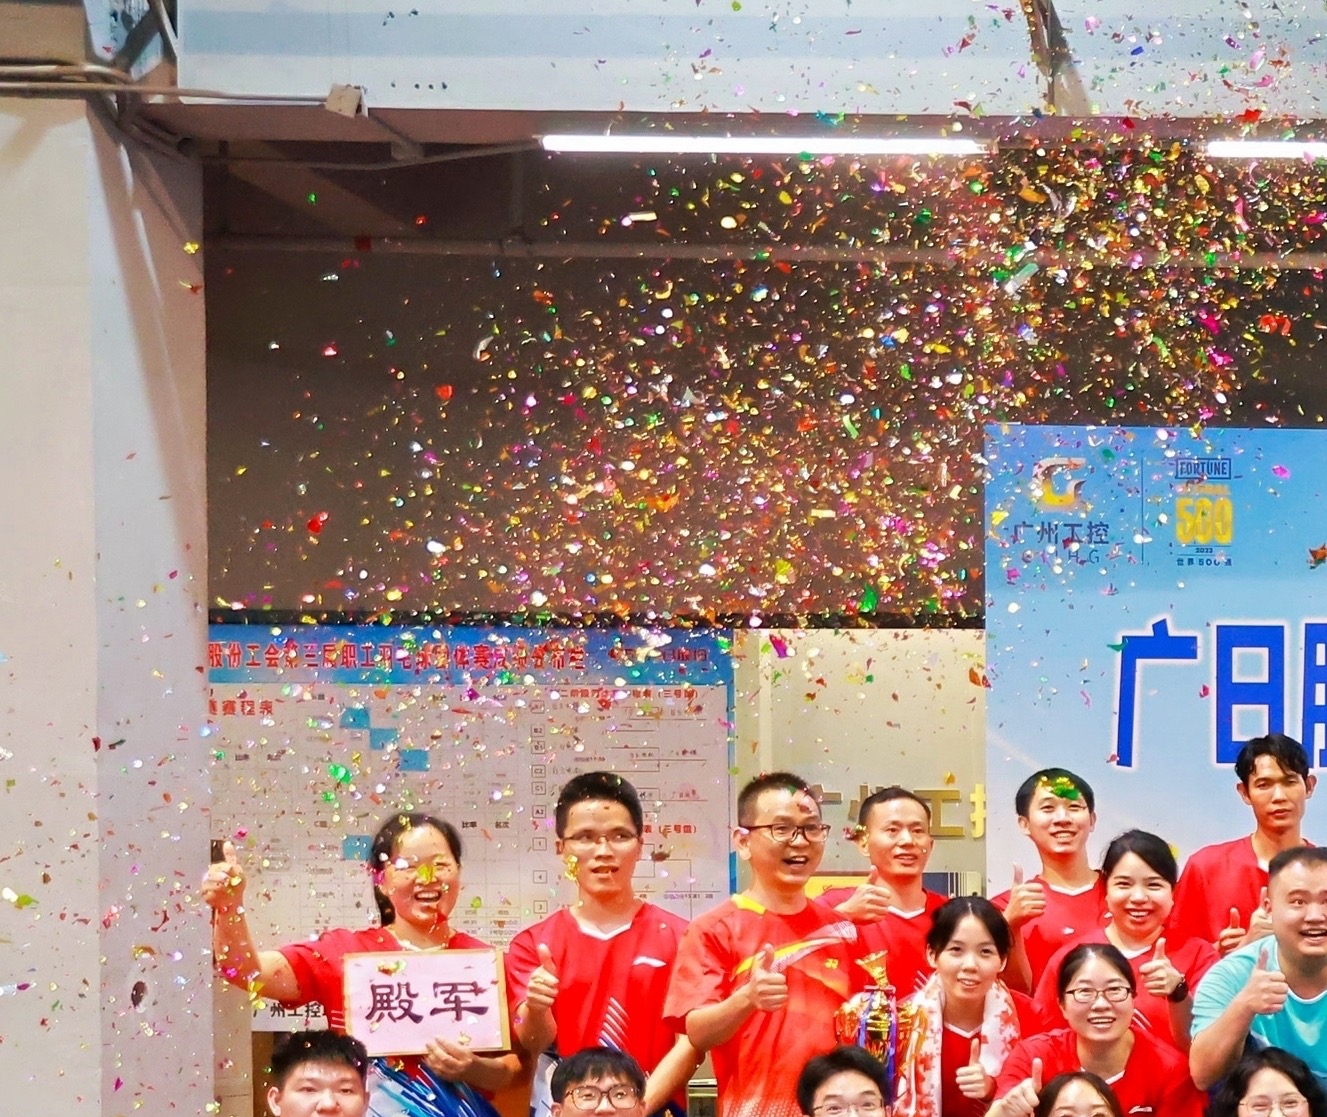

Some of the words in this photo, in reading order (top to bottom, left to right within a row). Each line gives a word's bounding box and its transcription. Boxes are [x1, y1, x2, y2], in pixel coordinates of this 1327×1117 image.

[1180, 462, 1227, 475] FORTUNE
[1175, 497, 1232, 544] 500
[365, 981, 489, 1024] 殿军
